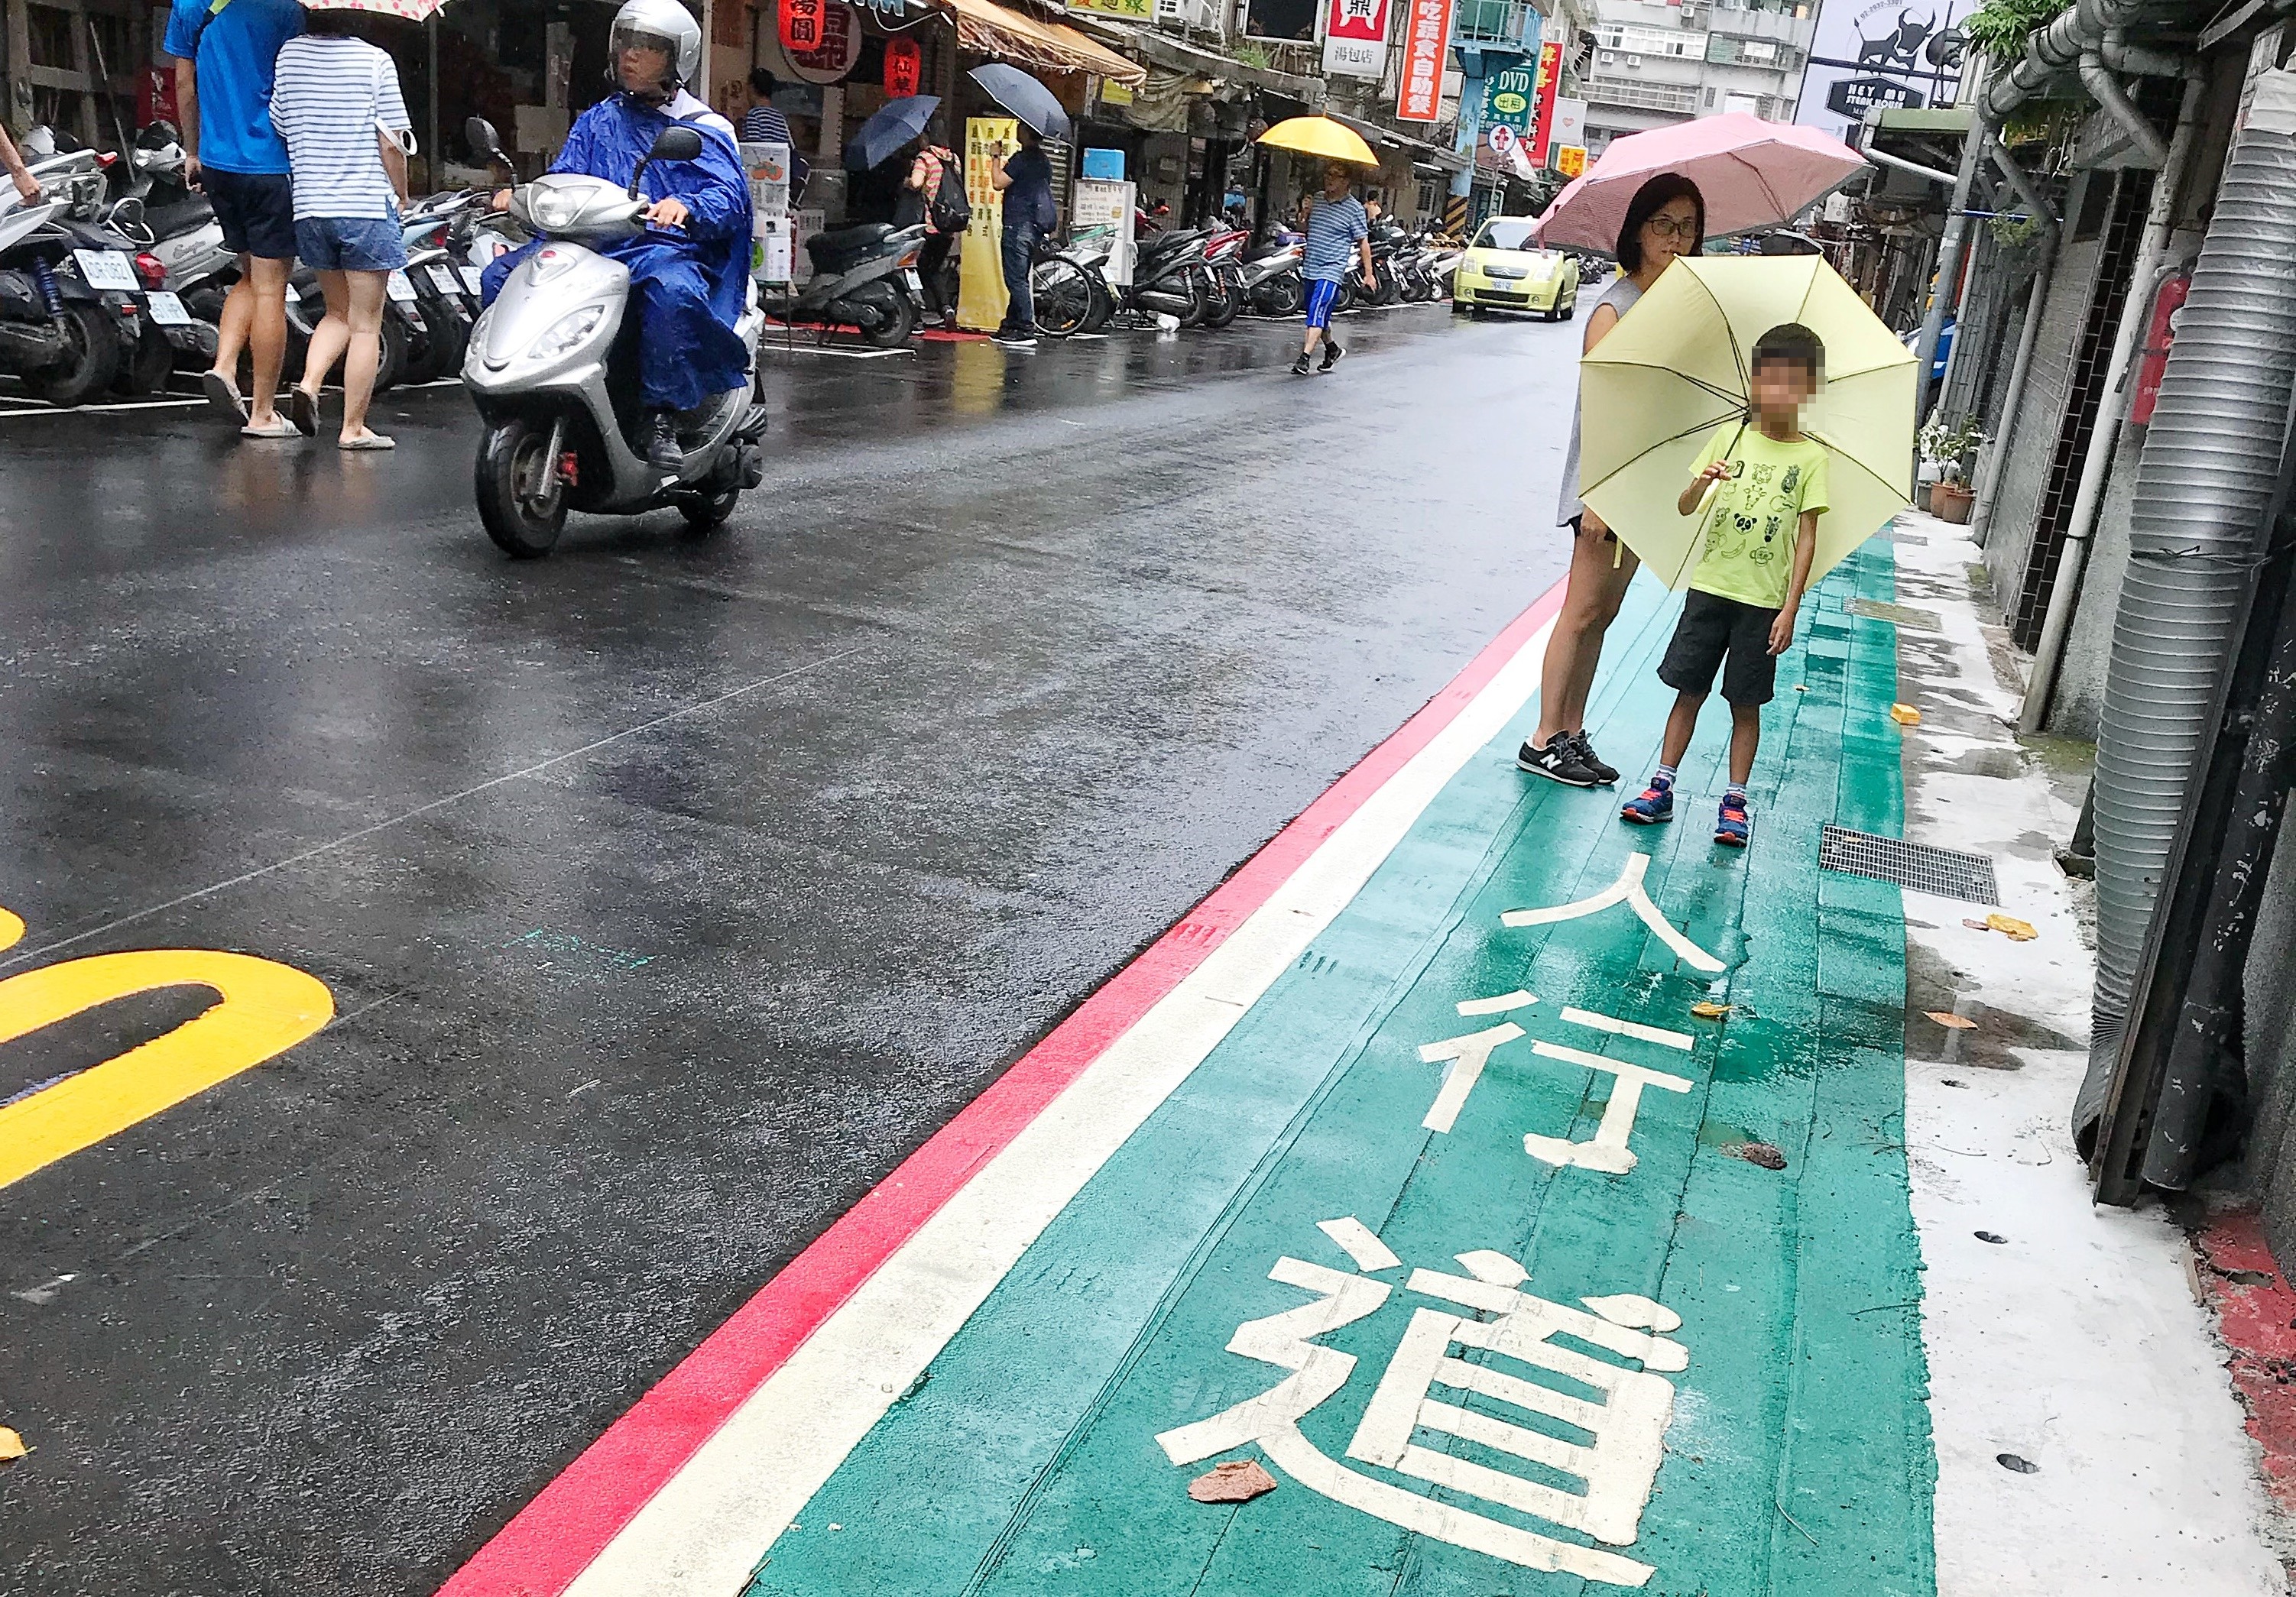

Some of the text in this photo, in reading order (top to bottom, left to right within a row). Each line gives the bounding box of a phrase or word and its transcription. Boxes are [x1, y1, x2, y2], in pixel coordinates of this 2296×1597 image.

[1498, 70, 1529, 92] DVD
[1847, 83, 1876, 97] HEY
[1845, 95, 1874, 106] STEAK
[1154, 851, 1727, 1587] 人行道
